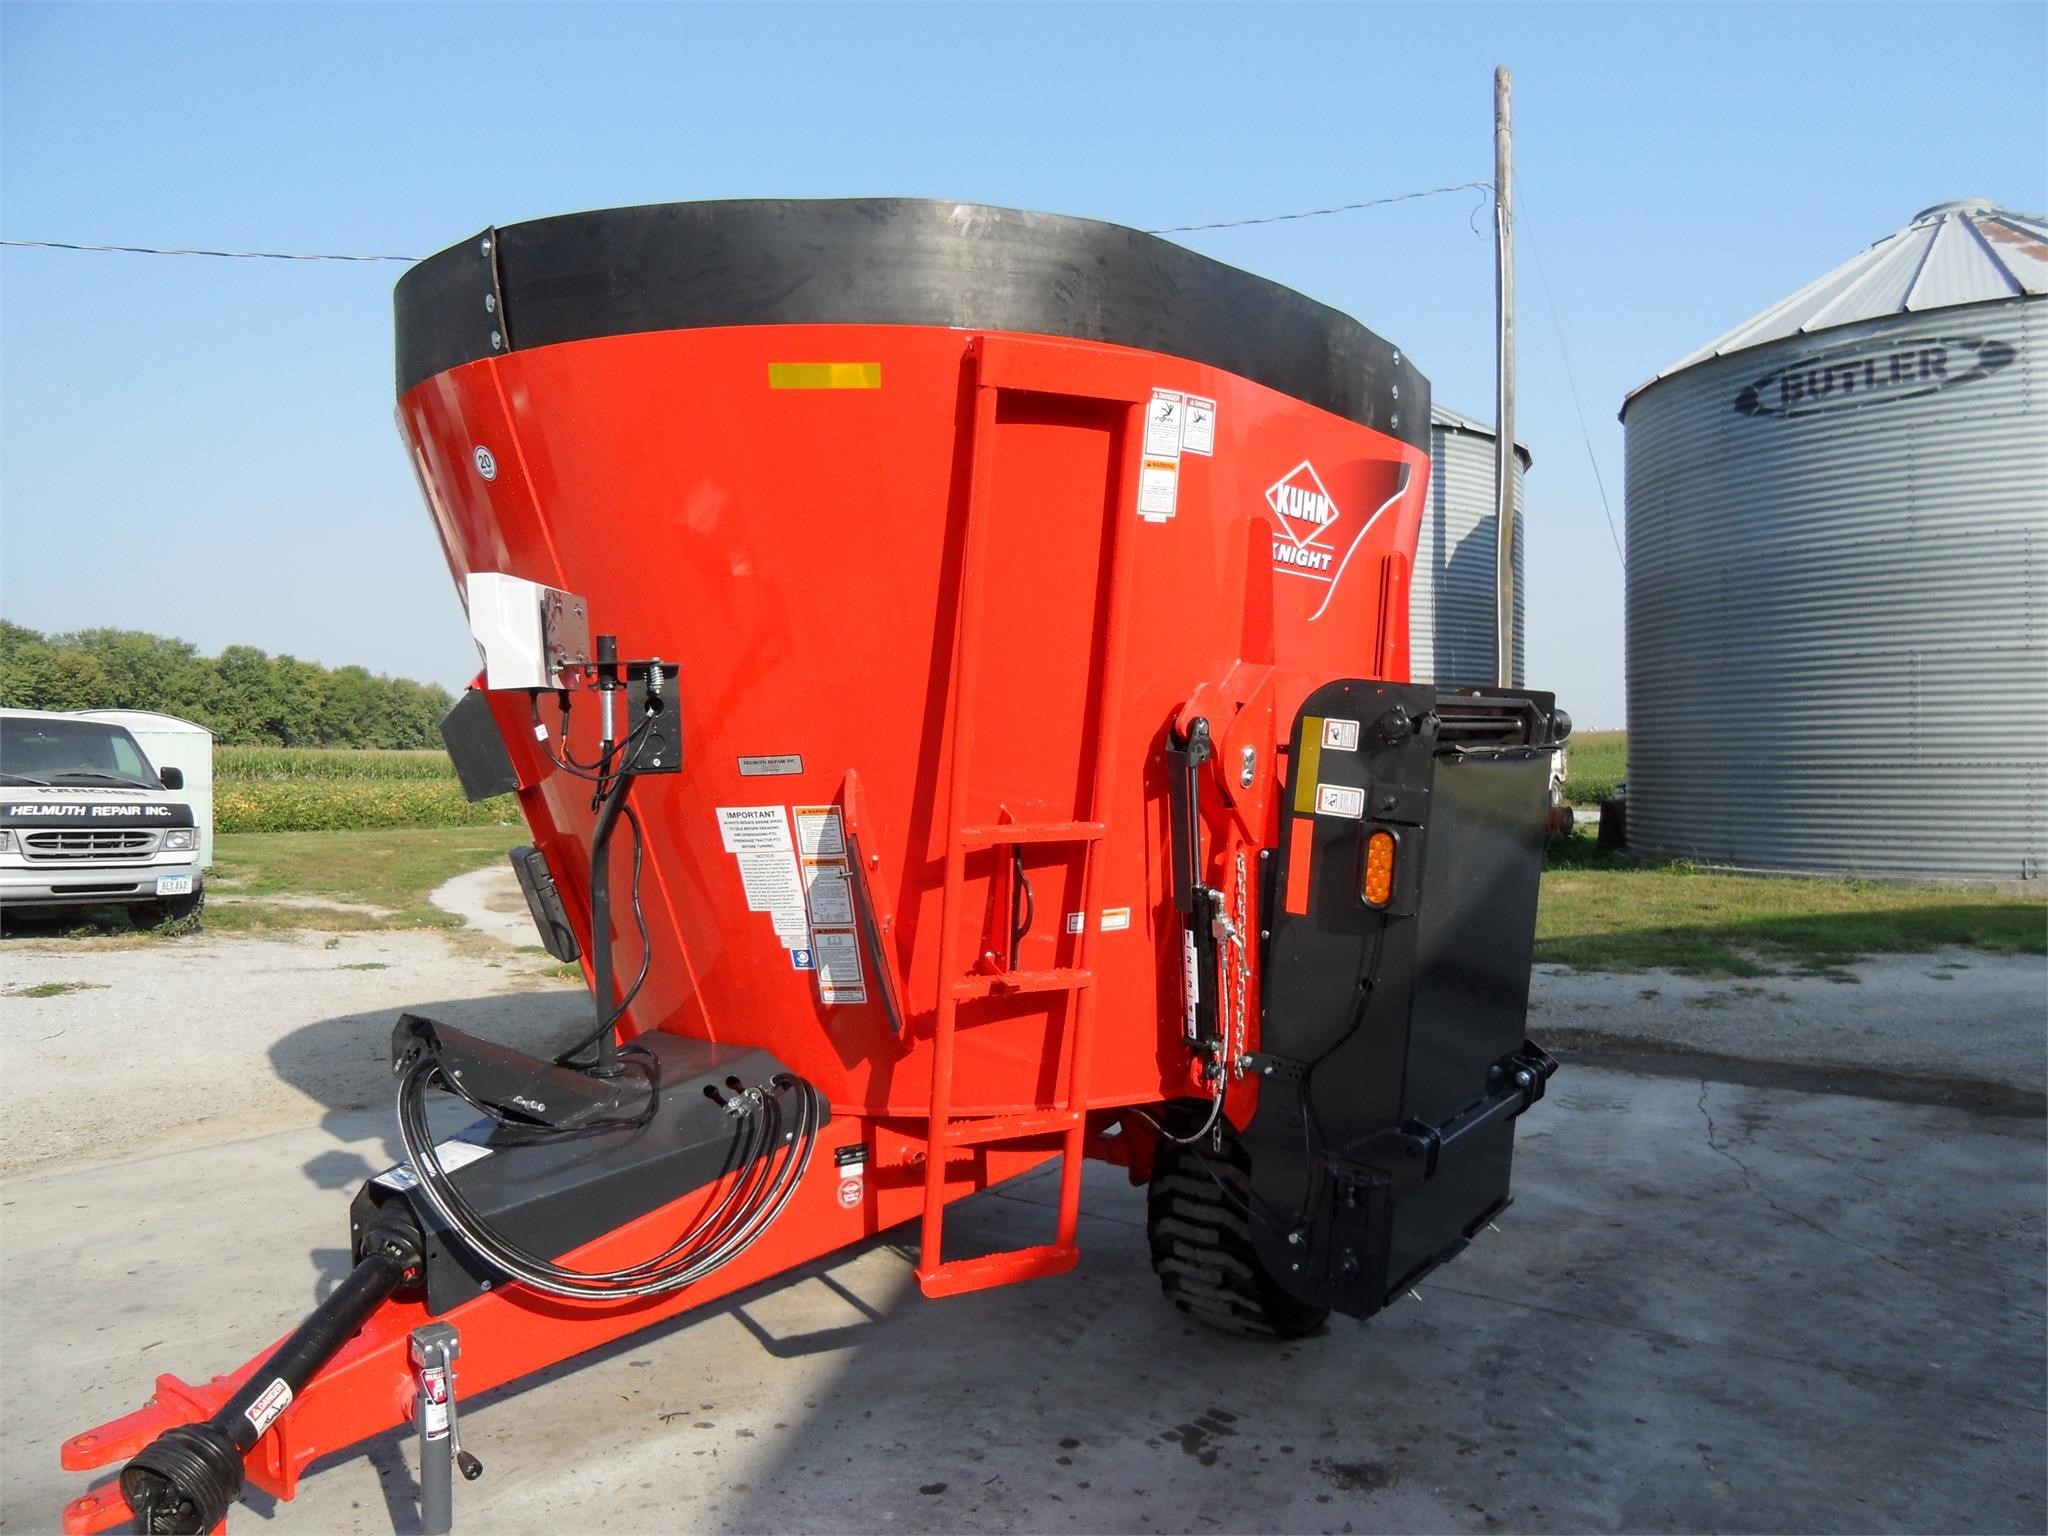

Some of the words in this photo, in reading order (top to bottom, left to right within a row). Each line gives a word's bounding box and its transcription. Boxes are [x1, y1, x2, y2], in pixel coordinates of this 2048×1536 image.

[1780, 347, 1947, 403] BUTLER
[478, 454, 491, 469] 20
[1276, 483, 1329, 526] KUHN
[10, 805, 87, 816] HELMUTH
[91, 805, 141, 816] REPAIR
[145, 805, 172, 816] INC.
[726, 810, 775, 818] IMPORTANT
[1187, 956, 1192, 964] 2
[1188, 980, 1192, 988] 3
[259, 1384, 284, 1409] DANGER
